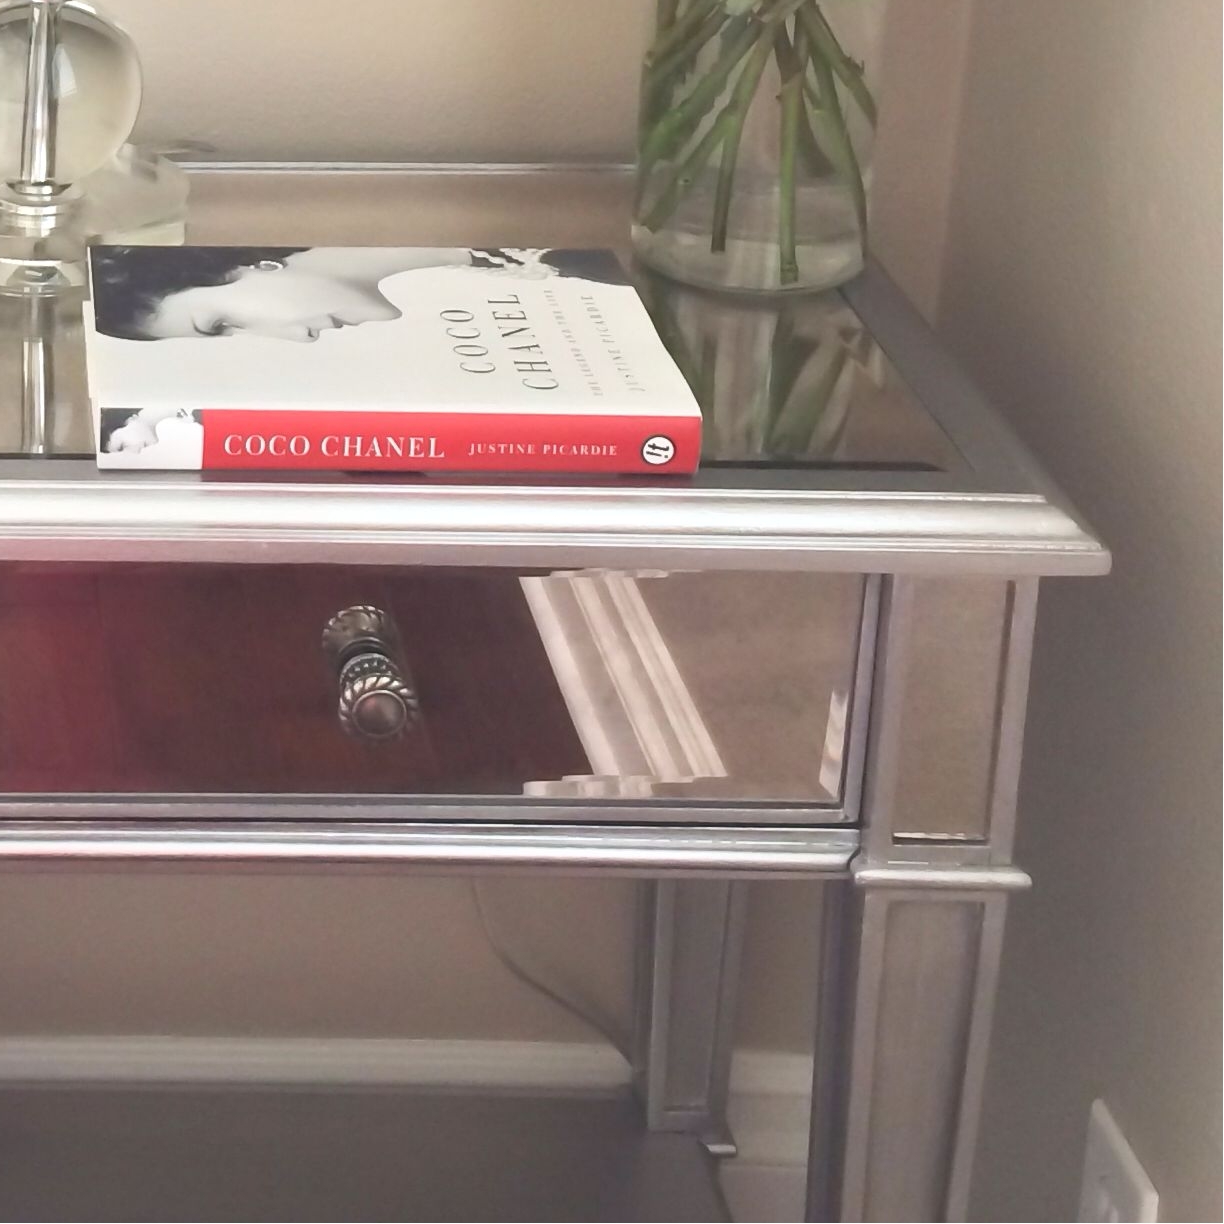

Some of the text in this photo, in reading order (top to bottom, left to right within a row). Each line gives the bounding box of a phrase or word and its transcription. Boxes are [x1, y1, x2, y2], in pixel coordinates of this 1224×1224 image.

[440, 309, 496, 374] COCO
[487, 293, 559, 390] CHANEL
[224, 434, 445, 458] COCO CHANEL
[468, 443, 618, 457] JUSTINE PICARDIE
